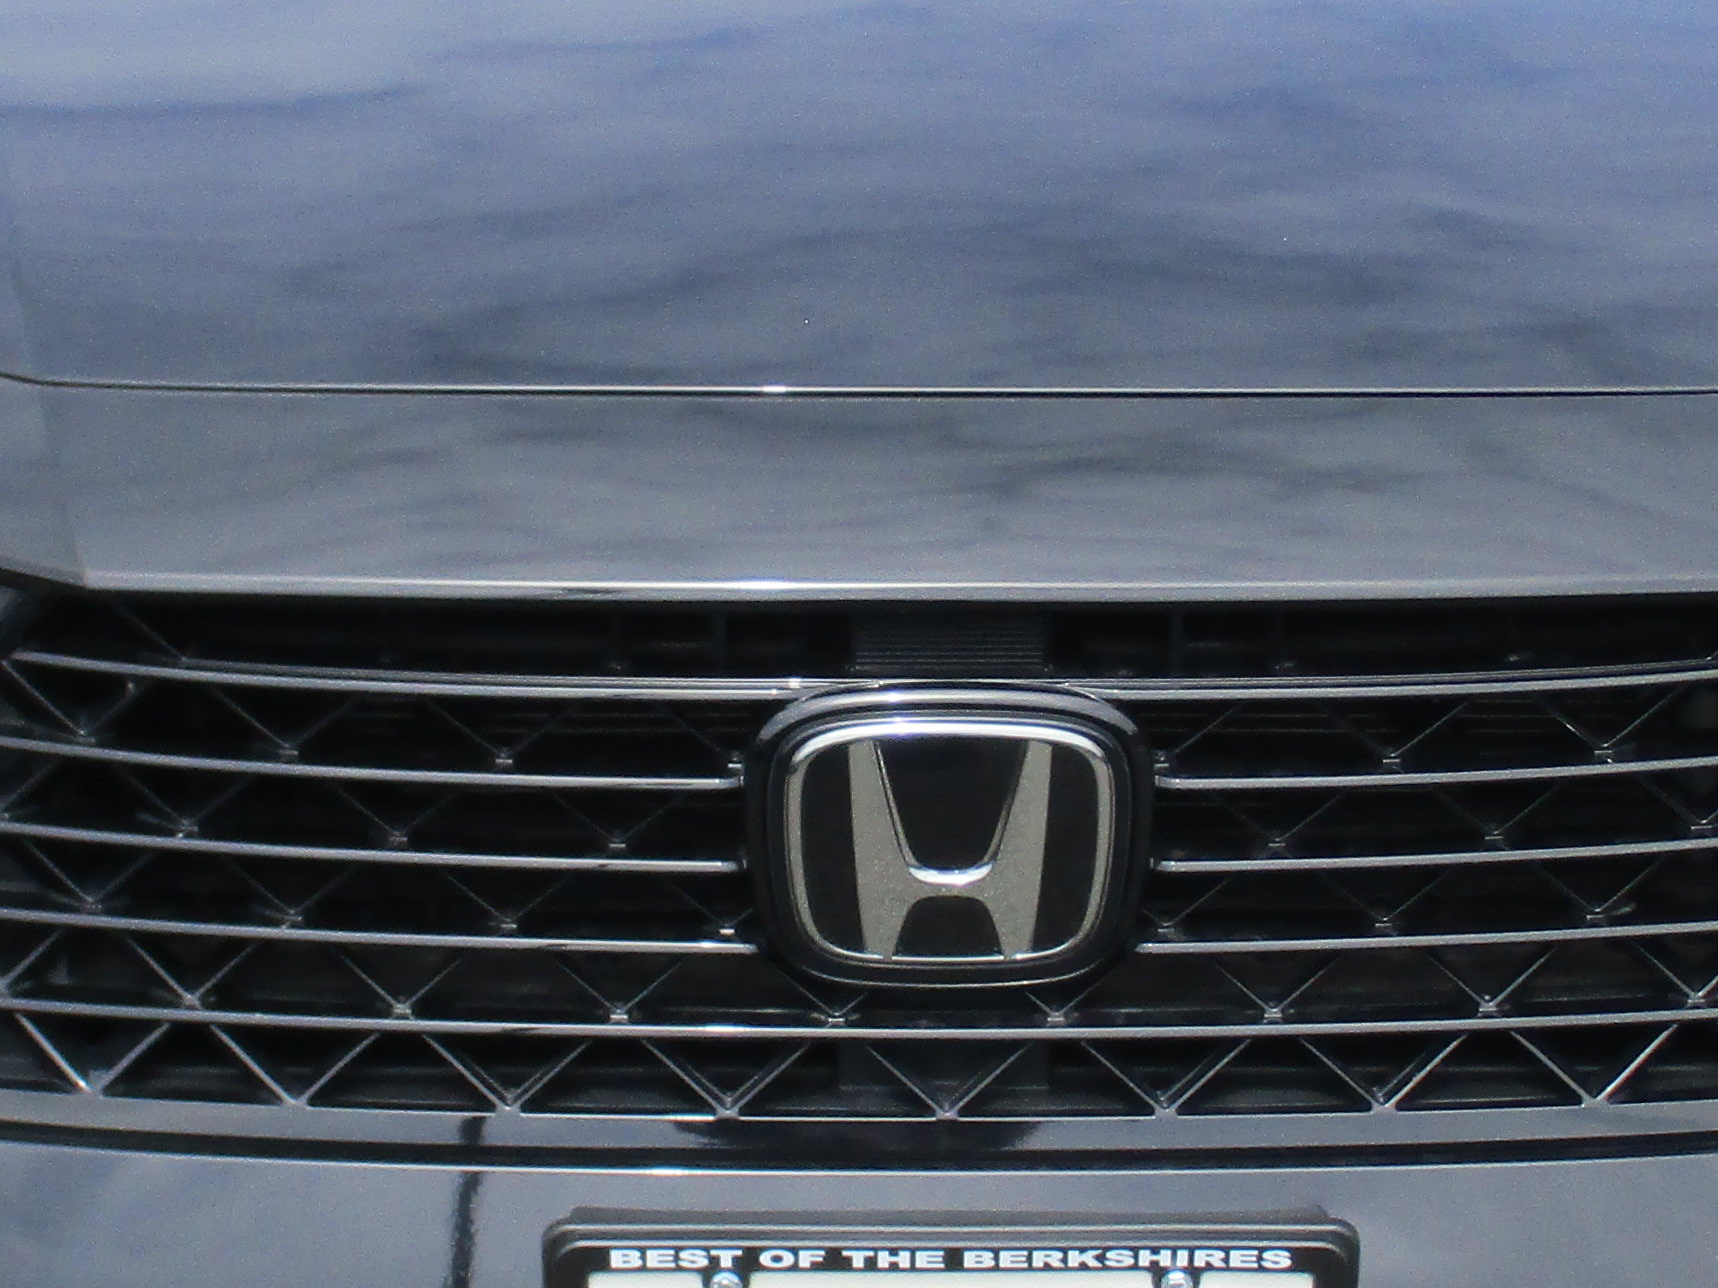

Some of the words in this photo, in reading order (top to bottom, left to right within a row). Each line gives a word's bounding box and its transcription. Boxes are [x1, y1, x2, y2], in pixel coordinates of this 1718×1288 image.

[608, 1248, 744, 1270] BEST
[758, 1248, 827, 1270] OF
[841, 1249, 946, 1270] THE
[962, 1248, 1294, 1269] BERKSHIRES
